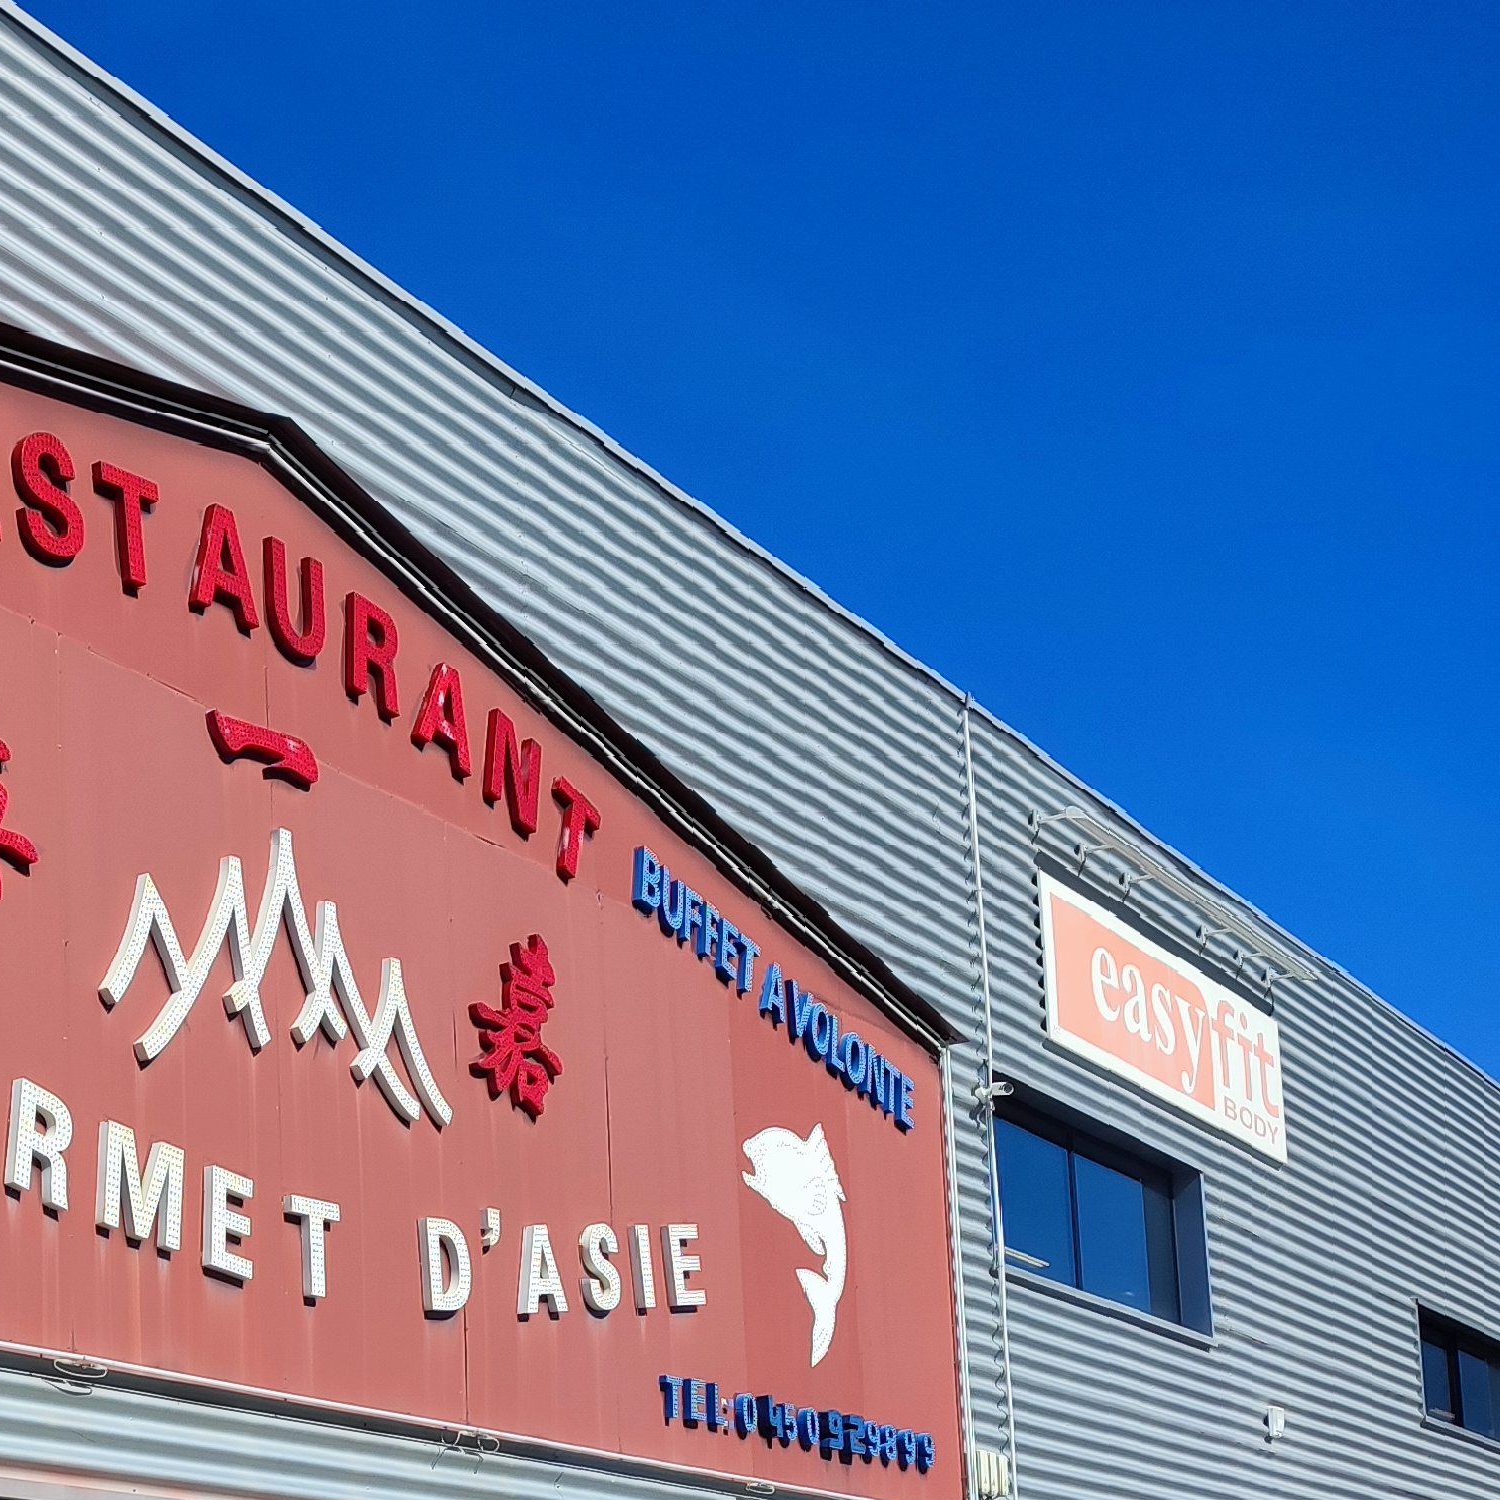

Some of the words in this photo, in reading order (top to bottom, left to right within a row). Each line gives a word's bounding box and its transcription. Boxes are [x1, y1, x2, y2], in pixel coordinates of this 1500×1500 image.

[632, 845, 761, 993] BUFFET
[785, 979, 915, 1131] VOLONTE
[1224, 1095, 1279, 1145] BODY
